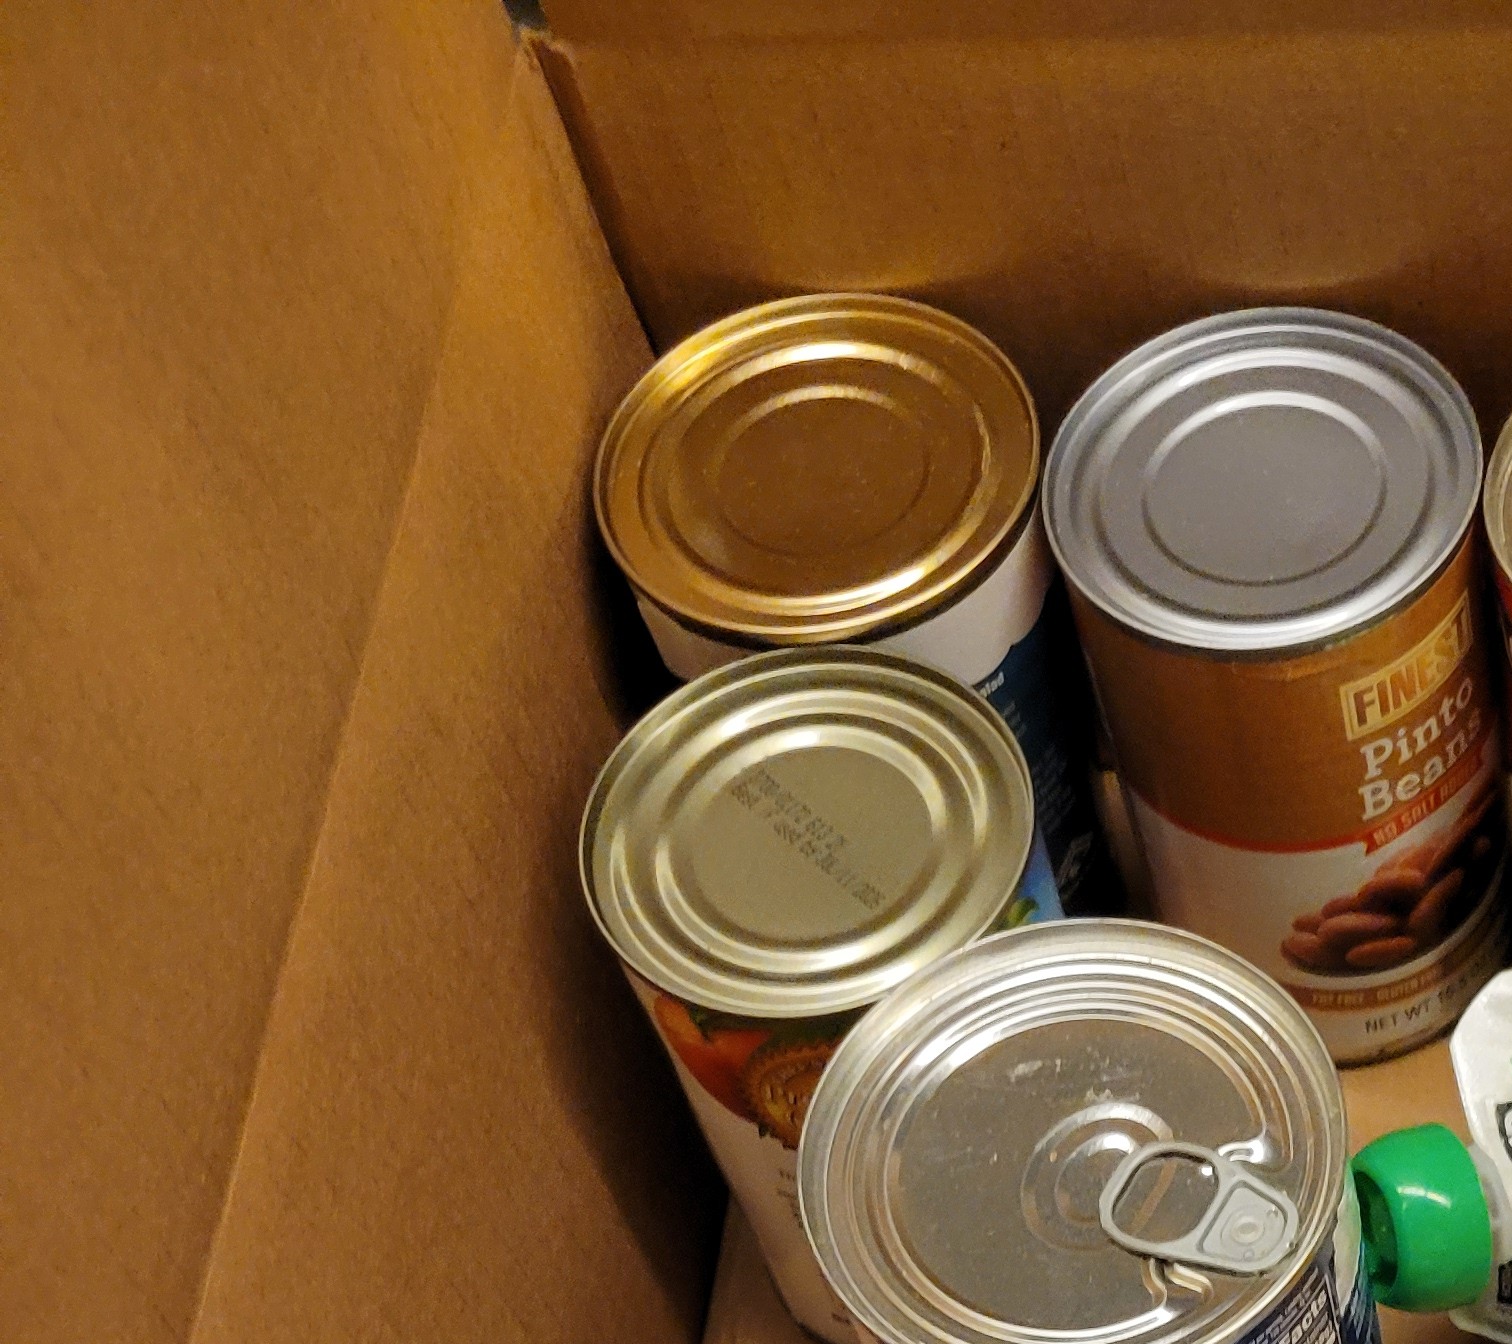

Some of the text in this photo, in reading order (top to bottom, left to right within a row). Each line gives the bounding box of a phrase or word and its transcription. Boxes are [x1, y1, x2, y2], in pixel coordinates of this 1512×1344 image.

[1353, 607, 1469, 727] FINEST
[1358, 707, 1481, 821] Beans
[1359, 677, 1473, 780] Pinto
[1364, 1001, 1431, 1034] NET WT
